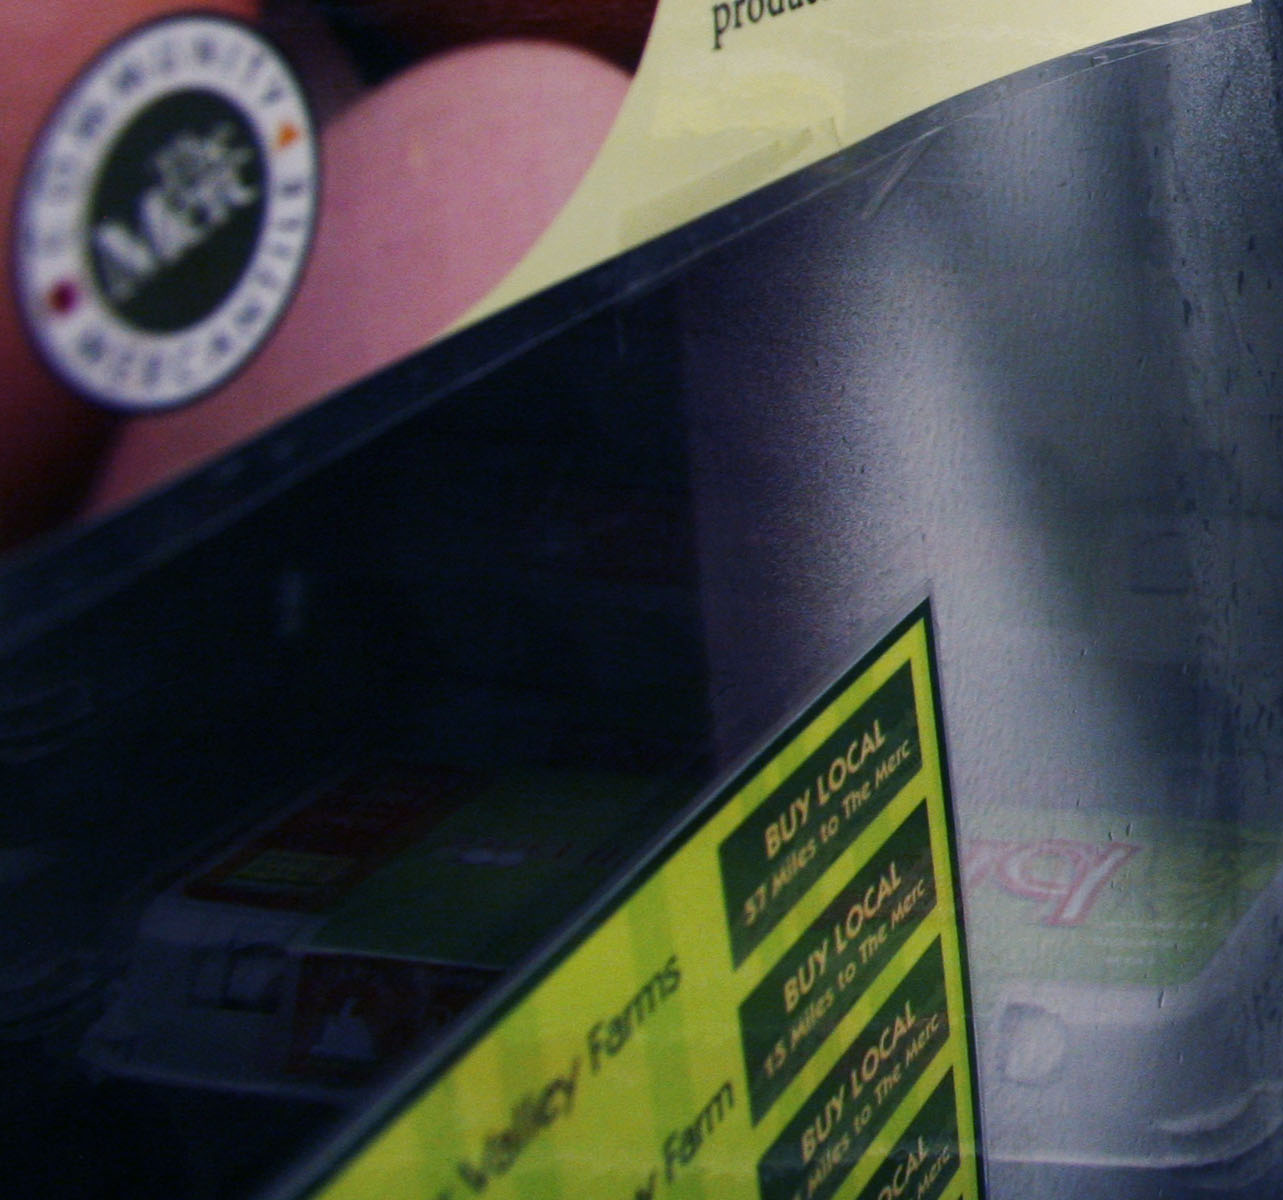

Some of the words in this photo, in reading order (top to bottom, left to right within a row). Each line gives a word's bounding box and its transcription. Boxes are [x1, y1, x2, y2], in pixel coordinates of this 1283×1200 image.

[763, 788, 812, 861] BUY
[817, 718, 887, 806] LOCAL
[783, 937, 829, 1014] BUY
[834, 861, 902, 956] LOCAL
